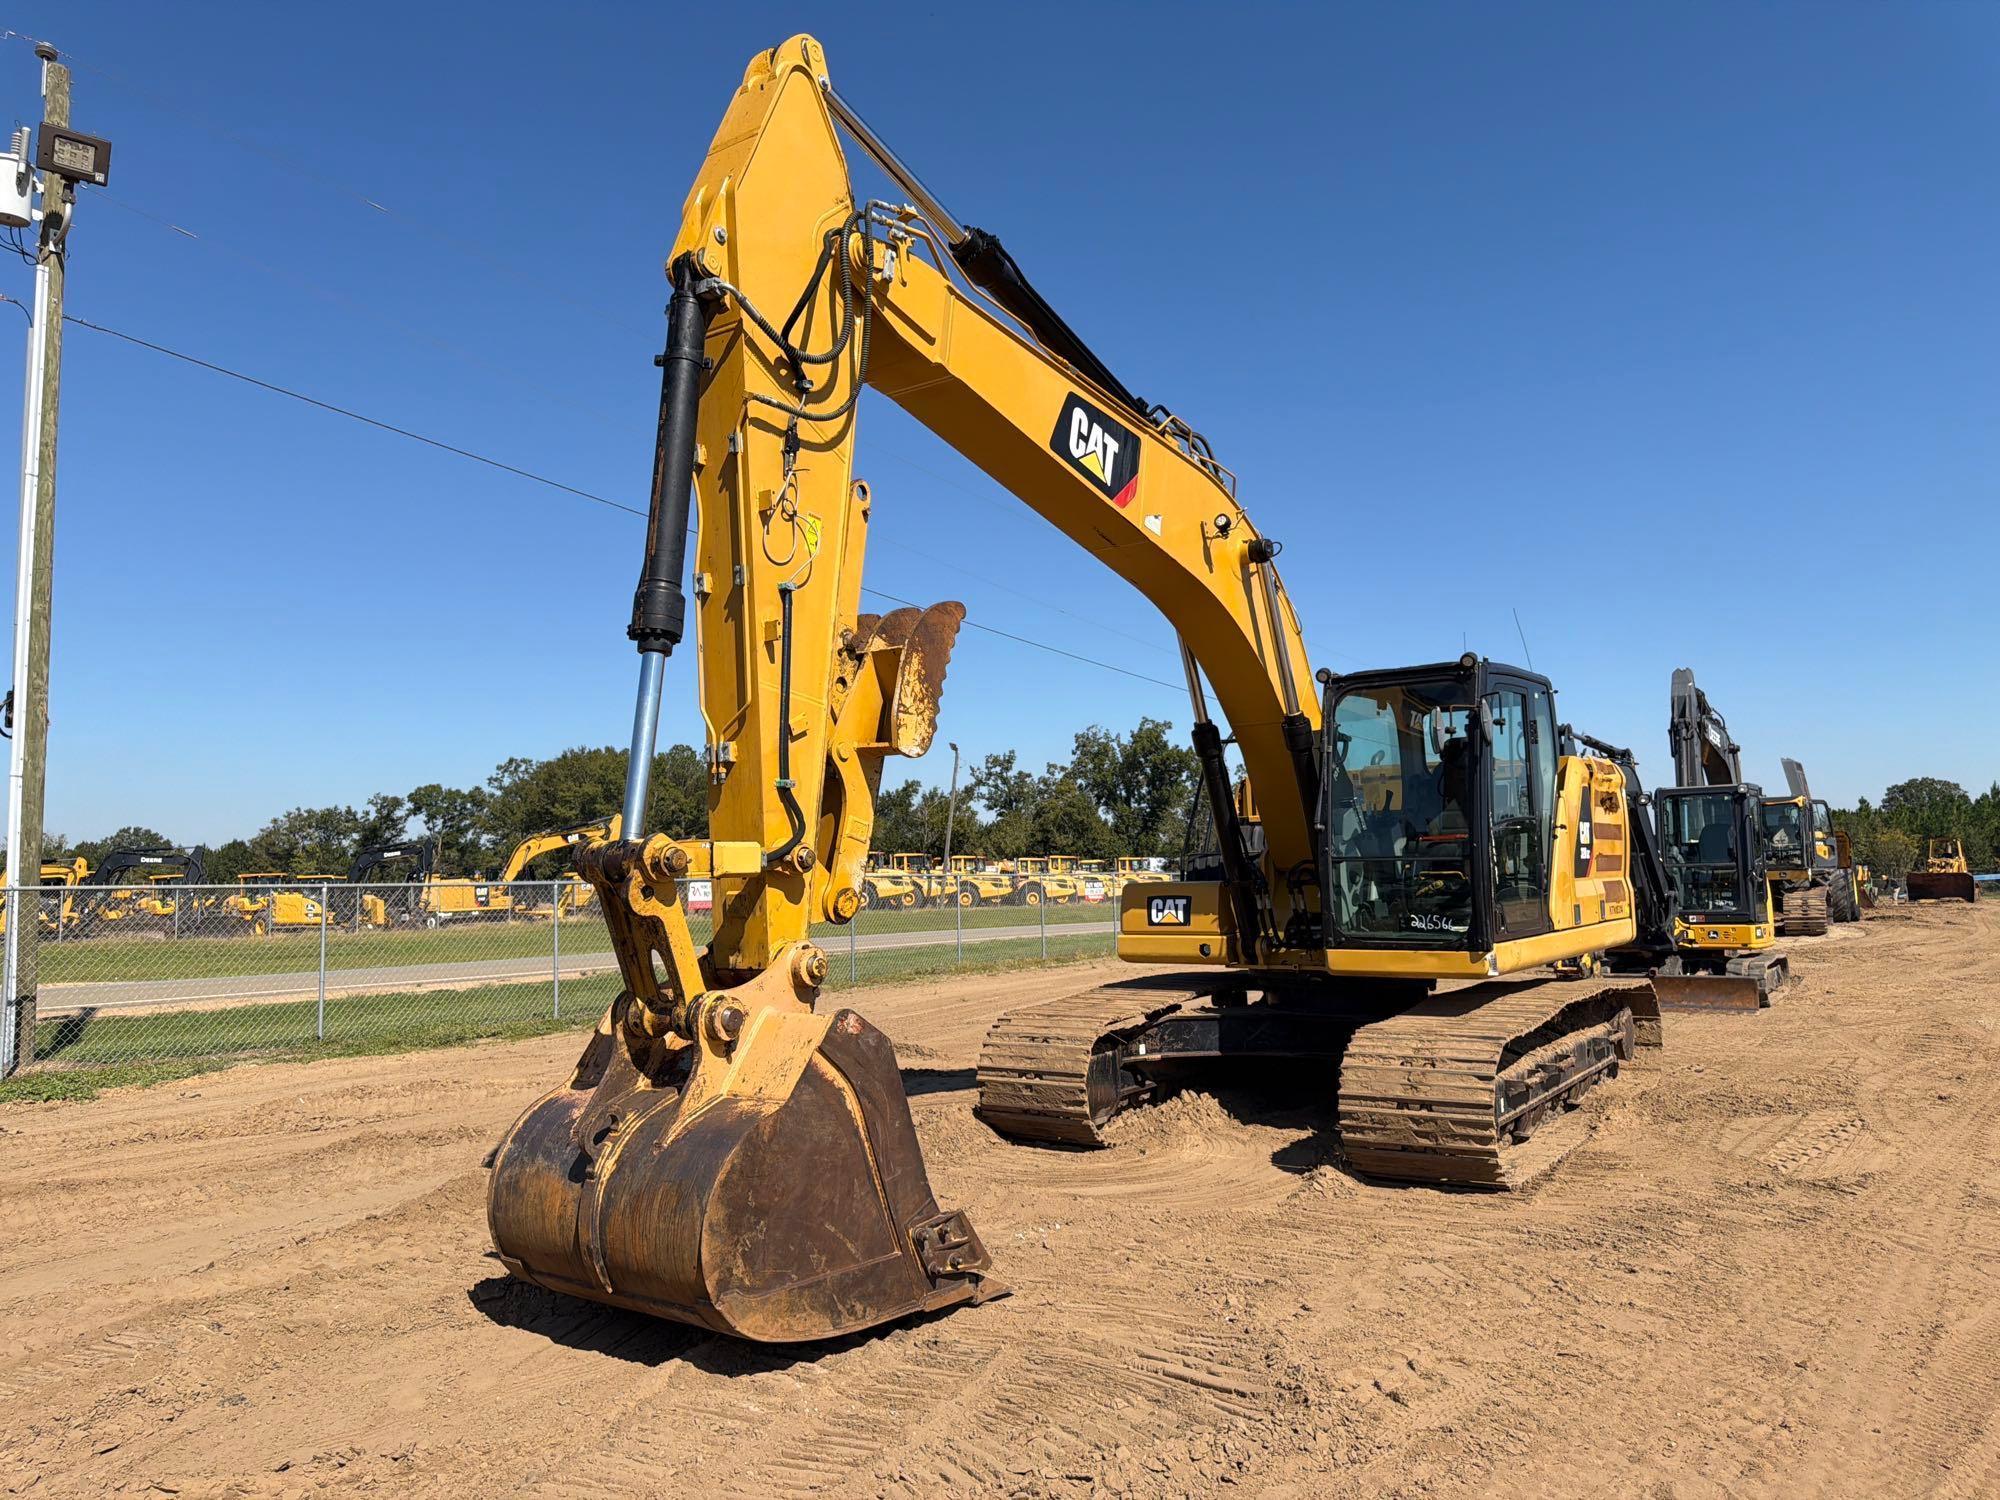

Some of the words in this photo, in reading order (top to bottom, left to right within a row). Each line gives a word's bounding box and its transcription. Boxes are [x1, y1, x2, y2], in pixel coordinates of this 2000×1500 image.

[1069, 406, 1120, 487] CAT
[1579, 821, 1591, 844] CAT
[1151, 898, 1187, 923] CAT
[1410, 914, 1455, 931] 226566
